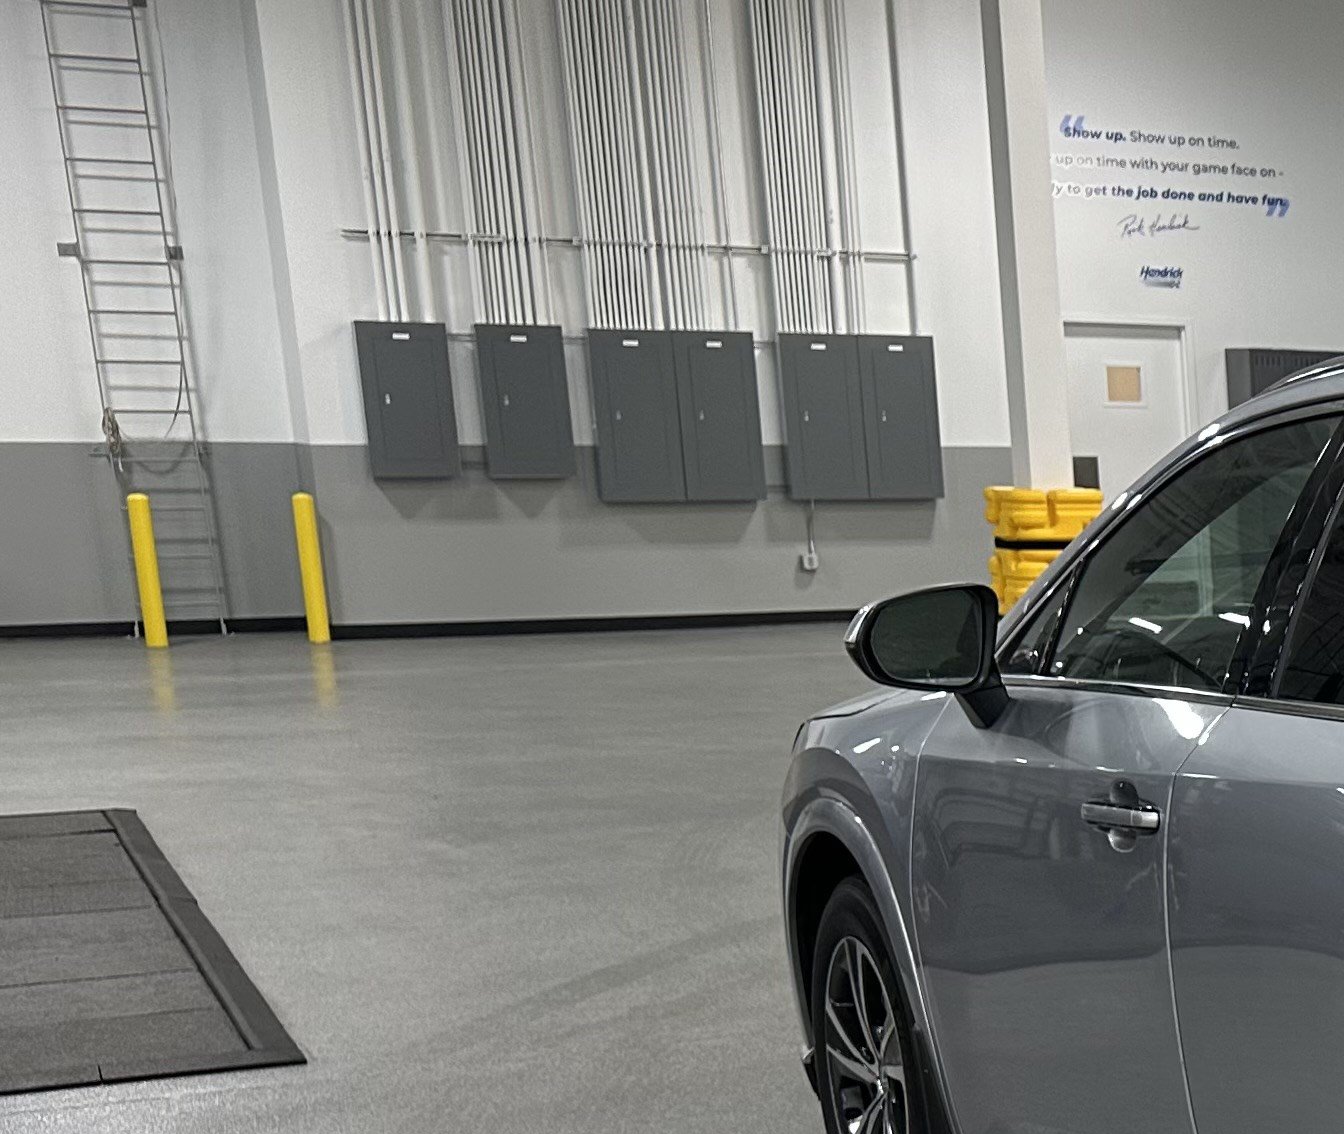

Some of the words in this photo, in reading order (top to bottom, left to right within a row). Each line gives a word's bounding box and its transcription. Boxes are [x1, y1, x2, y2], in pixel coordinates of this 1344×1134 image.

[1106, 131, 1127, 143] up.
[1130, 130, 1166, 144] Show
[1168, 136, 1186, 147] up
[1188, 136, 1205, 147] on
[1207, 136, 1240, 149] time.
[1055, 155, 1074, 166] up
[1076, 156, 1094, 165] on
[1096, 154, 1127, 168] time
[1129, 156, 1159, 170] with
[1160, 161, 1190, 173] your
[1192, 163, 1229, 175] game
[1231, 162, 1257, 177] face
[1260, 167, 1276, 177] on
[1067, 184, 1081, 194] to
[1085, 185, 1108, 197] get
[1111, 185, 1134, 197] the
[1135, 185, 1158, 200] job
[1161, 187, 1196, 200] done
[1198, 191, 1225, 203] and
[1226, 191, 1259, 205] have
